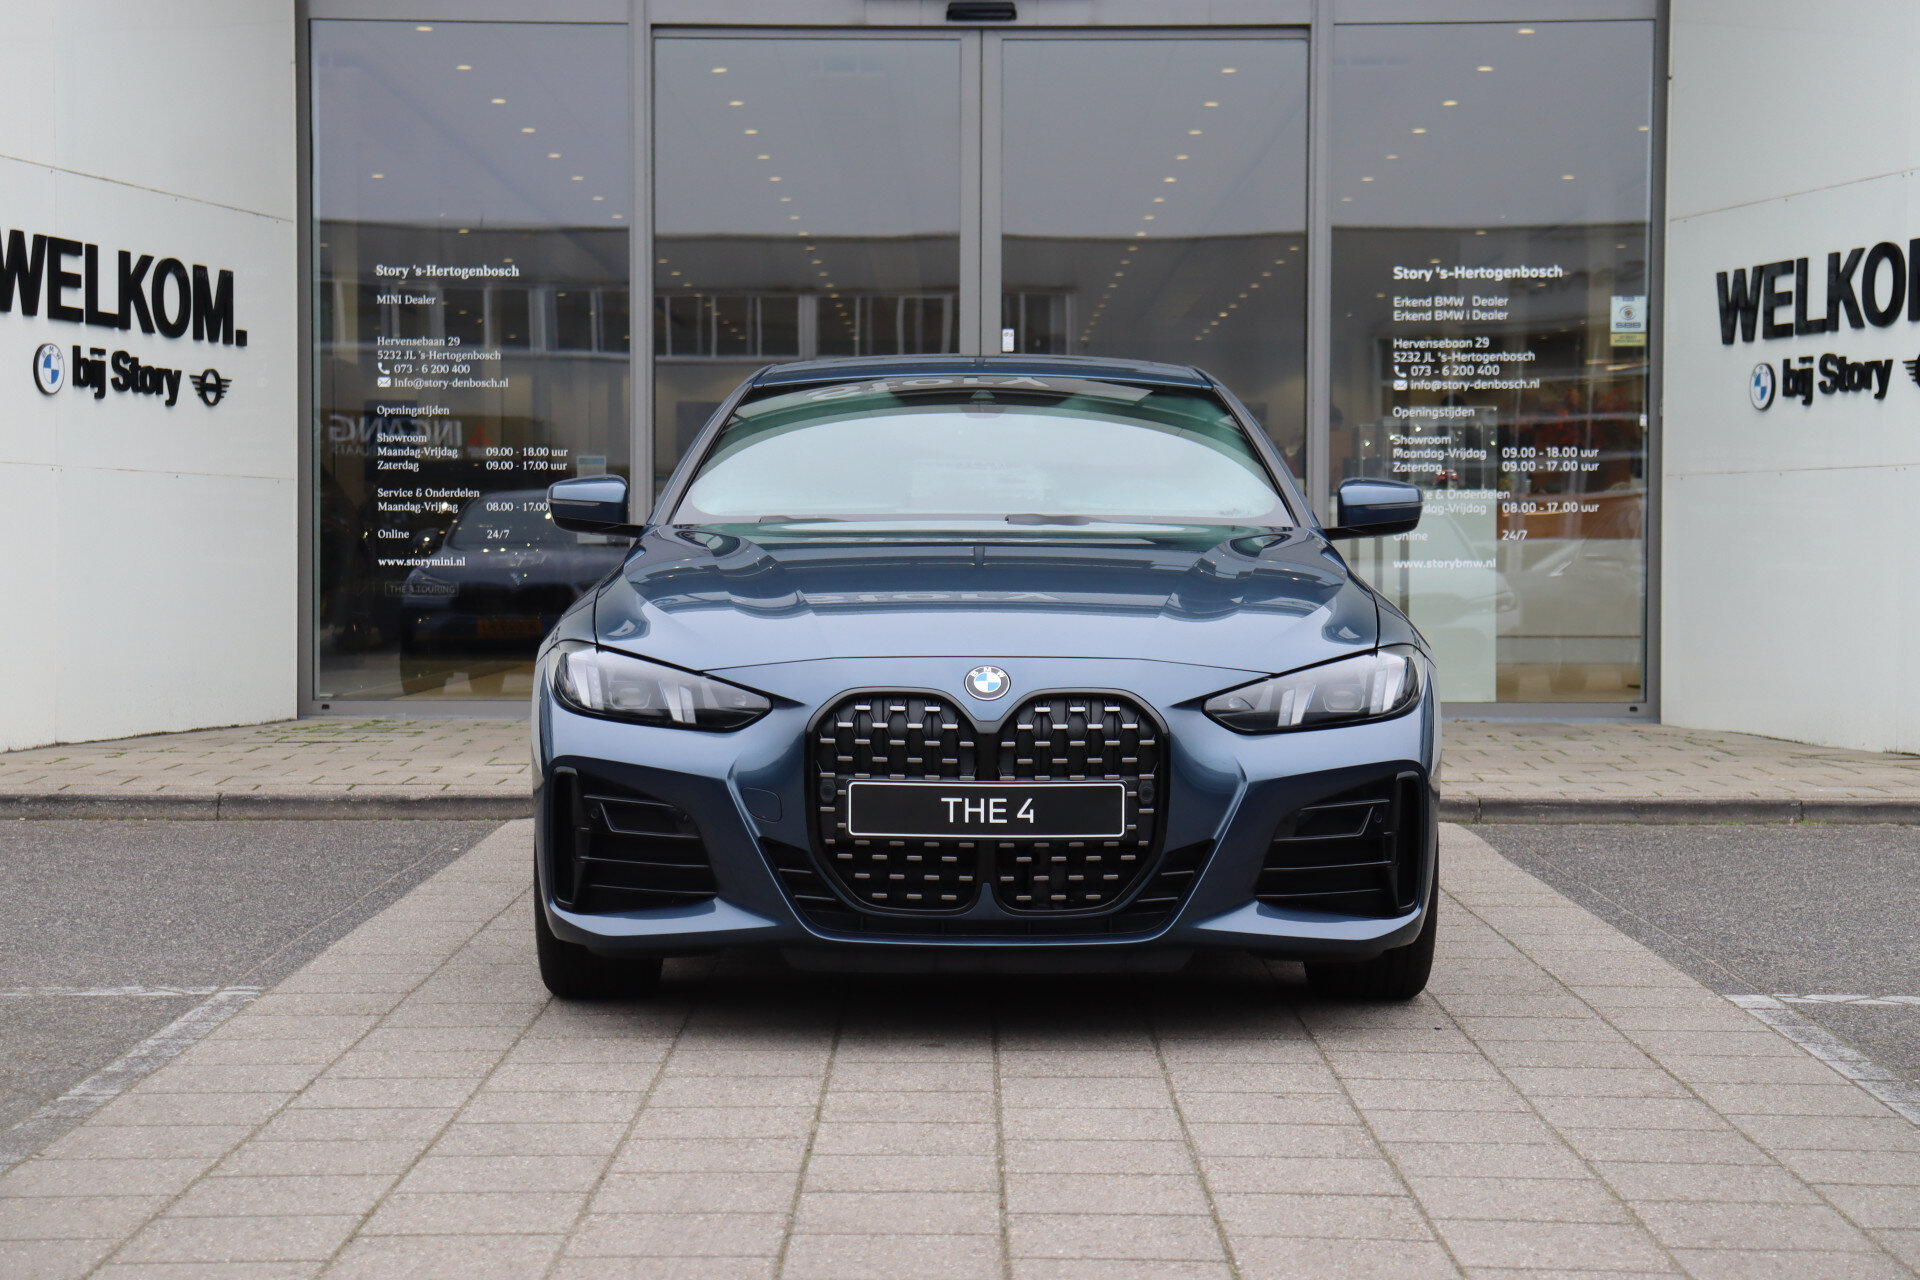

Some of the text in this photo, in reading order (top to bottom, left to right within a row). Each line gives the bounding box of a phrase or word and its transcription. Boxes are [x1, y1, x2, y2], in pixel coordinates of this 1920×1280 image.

[375, 264, 409, 279] Story
[1392, 265, 1434, 282] Story
[376, 294, 437, 305] MINI Dealer
[1393, 295, 1509, 308] Erkend BMW Dealer
[1393, 309, 1509, 322] Erkend BMW i Dealer
[377, 336, 461, 347] Hervensebaan 29
[1393, 336, 1490, 349] Hervensebaan 29
[377, 350, 402, 360] 5232
[404, 350, 416, 360] JL
[1393, 352, 1421, 363] 5232
[1422, 352, 1436, 363] JL
[393, 363, 413, 374] 073
[421, 363, 429, 374] 6
[430, 363, 450, 374] 200
[451, 363, 471, 374] 400
[1410, 365, 1432, 376] 073
[1441, 365, 1450, 376] 6
[1452, 365, 1475, 376] 200
[1476, 364, 1500, 376] 400
[72, 345, 182, 407] bij Story
[1782, 353, 1894, 407] bij Story
[394, 377, 509, 390] info@story-denbosch.nl
[1410, 378, 1540, 392] info@story-denbosch.nl
[376, 405, 450, 417] Openingstijden
[1392, 406, 1476, 419] Openingstijden
[376, 433, 428, 443] Showroom
[1392, 434, 1452, 445] Showroom
[376, 447, 459, 459] Maandag-Vrijdag
[486, 447, 514, 457] 09.00
[523, 447, 549, 457] 18.00
[551, 449, 568, 457] uur
[1392, 448, 1487, 461] Maandag-Vrijdag
[1501, 447, 1536, 458] 09.00
[1546, 447, 1578, 458] 18.00
[1580, 448, 1600, 458] uur
[377, 460, 420, 473] Zaterdag
[486, 461, 514, 471] 09.00
[523, 461, 548, 471] 17.00
[550, 462, 568, 471] uur
[1392, 462, 1443, 475] Zaterdag
[1501, 461, 1536, 472] 09.00
[1546, 461, 1578, 472] 17.00
[1580, 462, 1600, 472] uur
[377, 487, 480, 498] Service & Onderdelen
[1435, 489, 1444, 500] &
[1447, 488, 1511, 500] Onderdelen
[486, 502, 514, 512] 08.00
[523, 502, 549, 512] 17.00
[1501, 502, 1536, 513] 08.00
[1546, 502, 1578, 513] 17.00
[1580, 504, 1600, 514] uur
[377, 529, 410, 539] Online
[486, 529, 510, 539] 24/7
[1501, 529, 1528, 541] 24/7
[377, 556, 466, 568] www.storymini.nl
[1392, 557, 1497, 569] www.storybmw.nl
[941, 797, 1035, 824] THE 4
